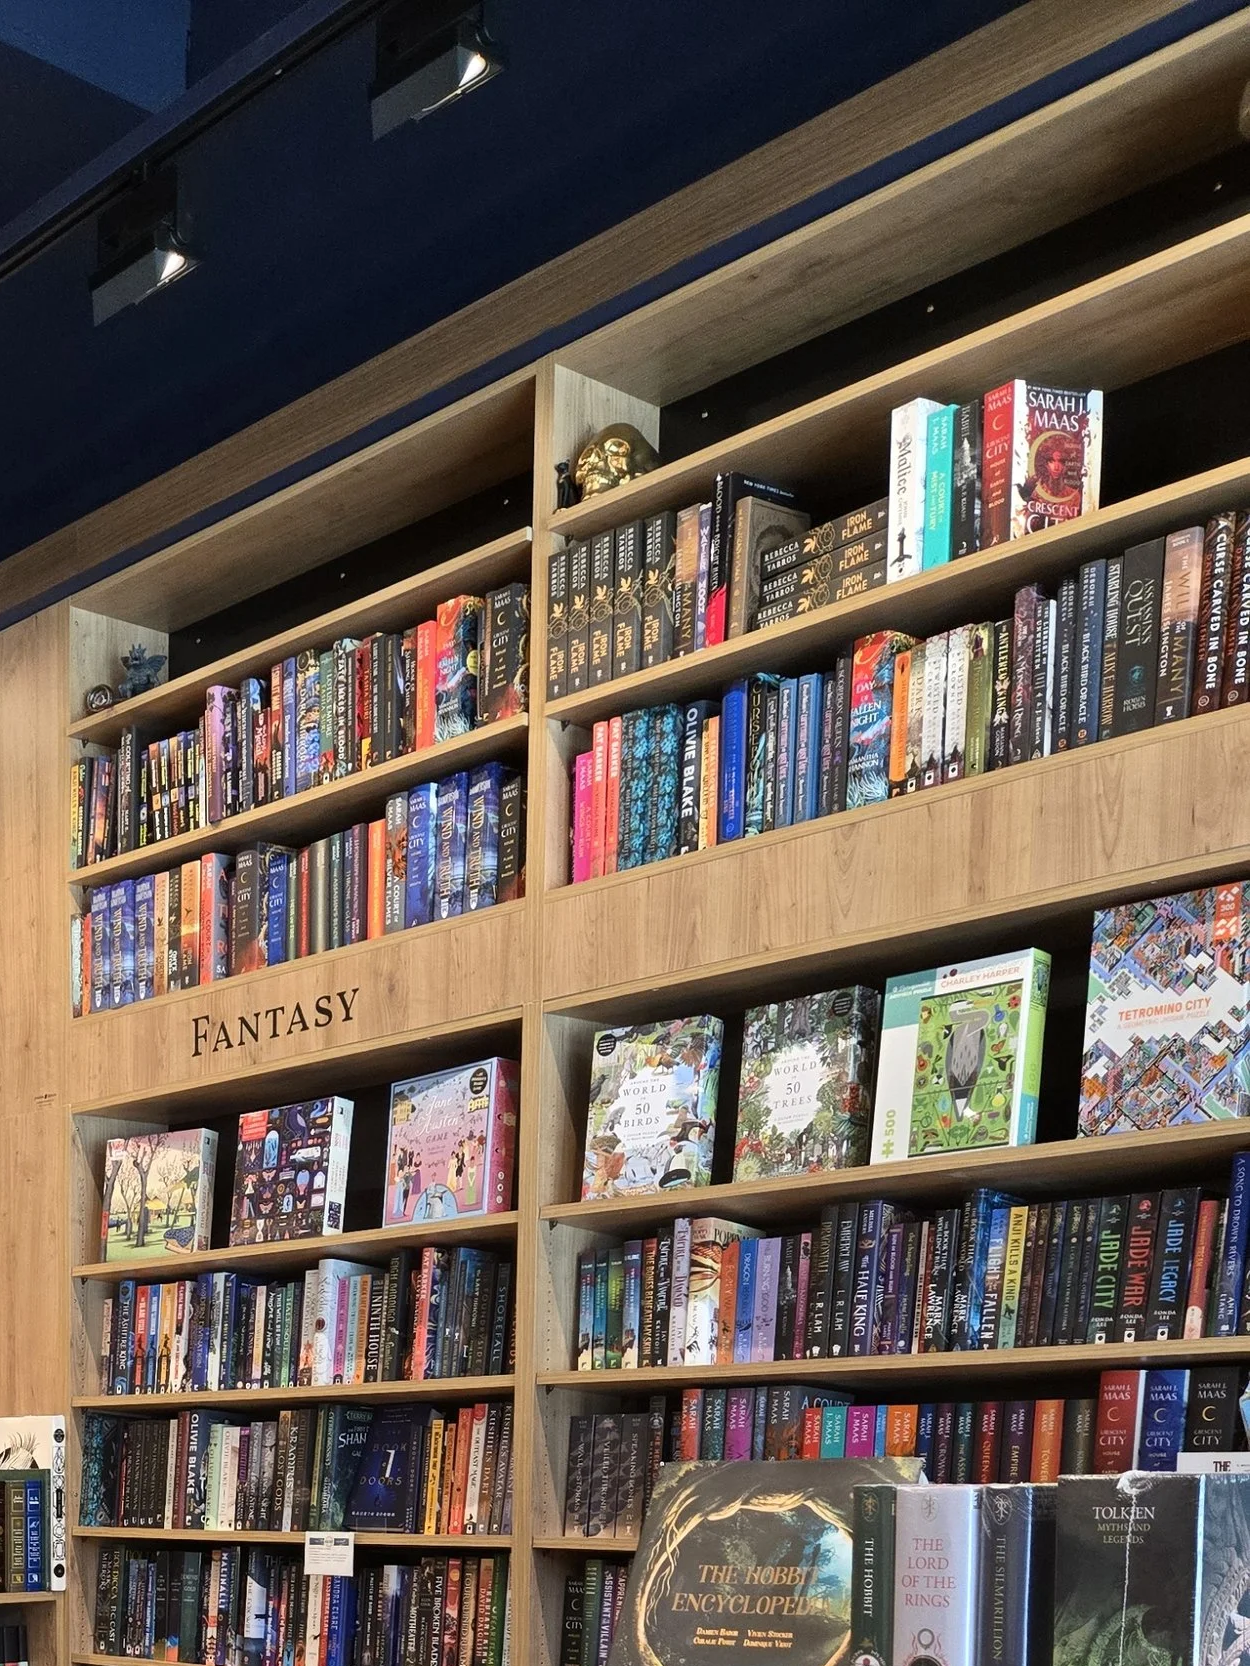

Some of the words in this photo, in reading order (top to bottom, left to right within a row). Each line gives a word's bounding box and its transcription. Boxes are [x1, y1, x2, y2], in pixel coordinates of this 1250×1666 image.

[987, 395, 1012, 412] MAAS
[1028, 391, 1075, 412] SARAH
[1078, 397, 1087, 416] J.
[1034, 411, 1080, 432] MAAS
[986, 443, 1009, 459] CITY
[896, 432, 913, 495] Malice
[1027, 500, 1080, 517] CRESCENT
[846, 511, 867, 528] IRON
[1027, 514, 1070, 534] CIT
[654, 519, 662, 564] REBECCA
[842, 522, 872, 540] FLAME
[764, 541, 800, 563] REBECCA
[845, 543, 864, 558] IRON
[1215, 532, 1227, 575] CURSE
[767, 553, 797, 573] YARROS
[839, 552, 870, 571] FLAME
[763, 572, 798, 593] REBECCA
[494, 595, 512, 610] MAAS
[766, 584, 795, 603] YARROS
[1125, 579, 1143, 647] QUEST
[1210, 578, 1223, 632] CARVED
[493, 634, 510, 648] CITY
[644, 615, 654, 651] FLAME
[1209, 636, 1219, 651] IN
[1170, 635, 1187, 694] MANY
[1205, 655, 1218, 690] BONE
[685, 707, 699, 763] OLIVIE
[681, 767, 695, 820] BLAKE
[472, 795, 485, 831] WIND
[940, 974, 982, 990] CHARLEY
[984, 966, 1020, 981] HARPER
[1118, 1001, 1183, 1022] TETROMINO
[1185, 997, 1212, 1012] CITY
[191, 987, 360, 1058] FANTASY
[773, 1061, 818, 1076] WORLD
[622, 1083, 667, 1097] WORLD
[785, 1081, 802, 1096] 50
[635, 1103, 651, 1115] 50
[773, 1095, 813, 1109] TREES
[623, 1116, 661, 1128] BIRDS
[885, 1109, 897, 1137] 500
[1012, 1213, 1024, 1235] ANJI
[1128, 1225, 1151, 1268] JADE
[1165, 1219, 1185, 1255] JADE
[1009, 1237, 1021, 1265] KILLS
[1099, 1229, 1121, 1272] JADE
[1006, 1278, 1016, 1302] KING
[1093, 1272, 1117, 1310] CITY
[1123, 1269, 1147, 1308] WAR
[1159, 1258, 1181, 1305] LEGACY
[853, 1302, 868, 1338] KING
[981, 1293, 998, 1340] FALLEN
[366, 1332, 379, 1371] HOUSE
[1103, 1391, 1131, 1401] MAAS
[1197, 1390, 1228, 1400] MAAS
[1099, 1436, 1127, 1447] CITY
[1193, 1435, 1222, 1447] CITY
[359, 1476, 403, 1486] DOORS
[1092, 1506, 1156, 1521] TOLKIEN
[1097, 1522, 1129, 1533] MYTHS
[1130, 1522, 1151, 1532] AND
[864, 1537, 875, 1563] THE
[912, 1538, 944, 1551] THE
[995, 1537, 1007, 1563] THE
[1102, 1534, 1144, 1545] LEGENDS
[907, 1557, 949, 1570] LORD
[699, 1564, 738, 1584] THE
[744, 1565, 819, 1585] HOBBIT
[901, 1575, 920, 1588] OF
[923, 1576, 957, 1589] THE
[862, 1565, 874, 1618] HOBBIT
[905, 1594, 951, 1608] RINGS
[993, 1565, 1006, 1661] SILMARILLION
